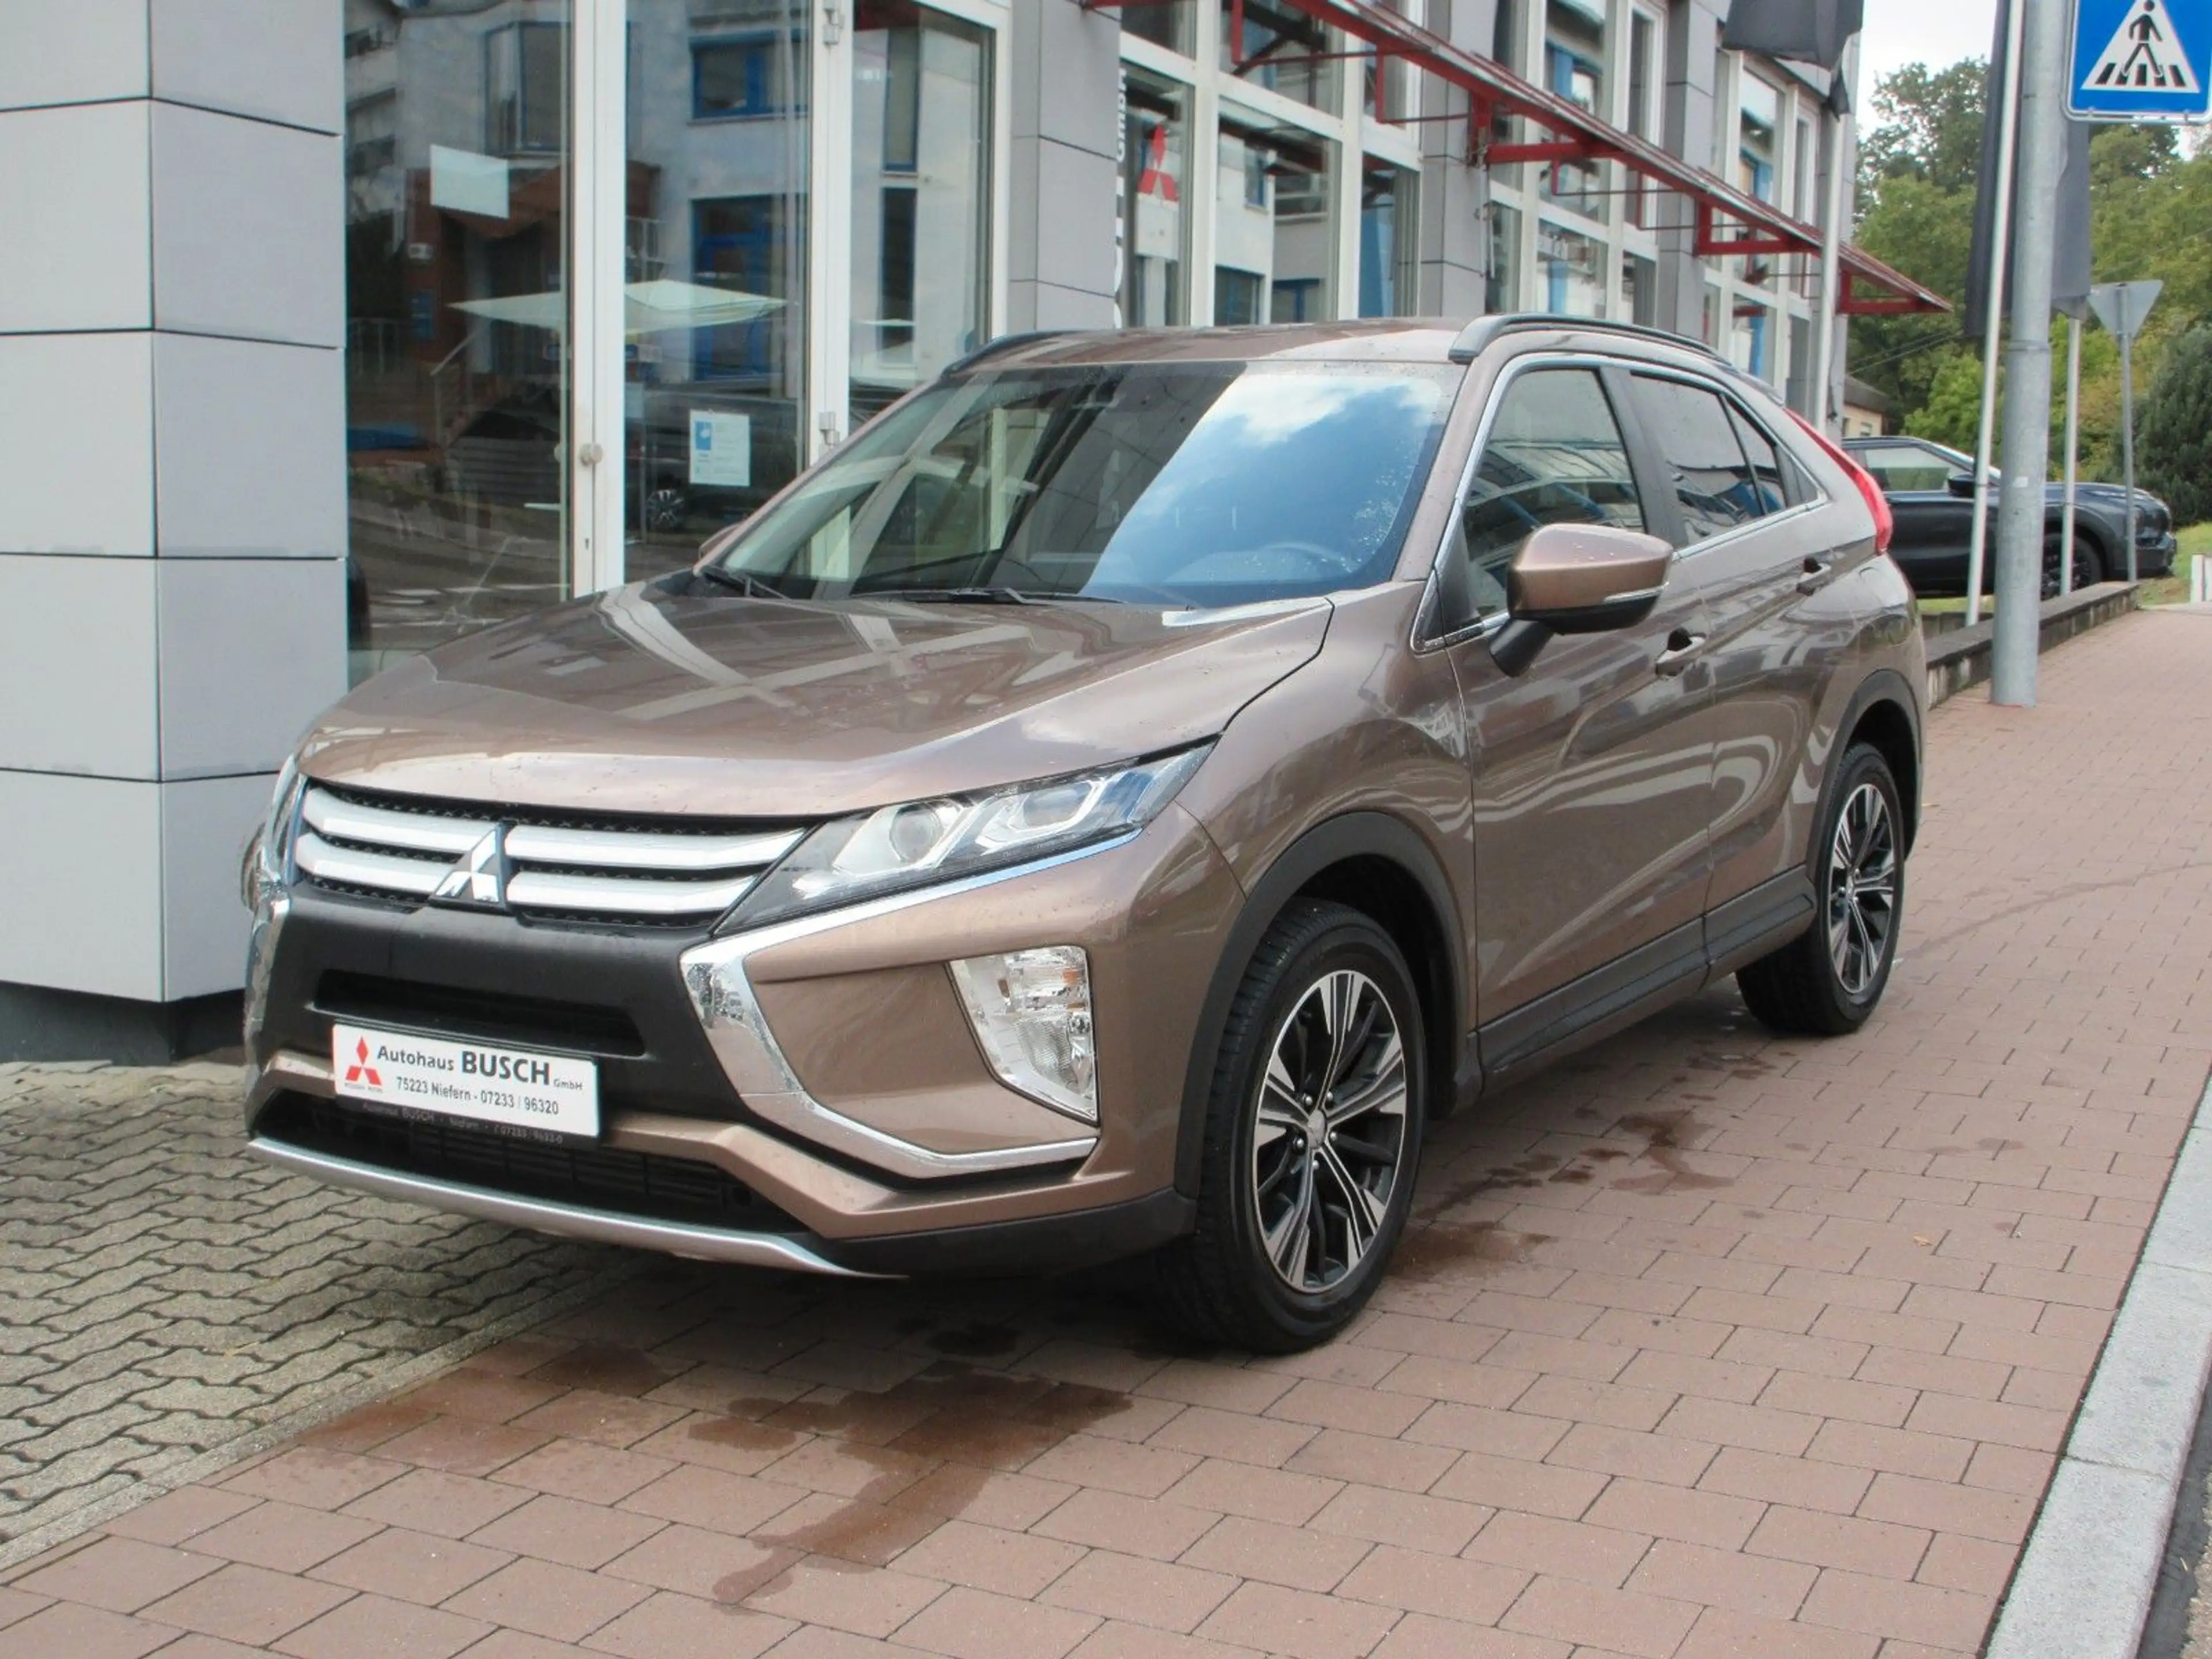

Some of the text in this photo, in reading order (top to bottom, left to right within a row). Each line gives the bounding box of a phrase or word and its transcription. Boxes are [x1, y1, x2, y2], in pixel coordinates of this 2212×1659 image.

[377, 1045, 583, 1090] Autohaus BUSCH GmbH
[396, 1076, 429, 1094] 75223
[431, 1082, 471, 1101] Niefern
[480, 1090, 514, 1108] 07233
[524, 1096, 559, 1115] 96320
